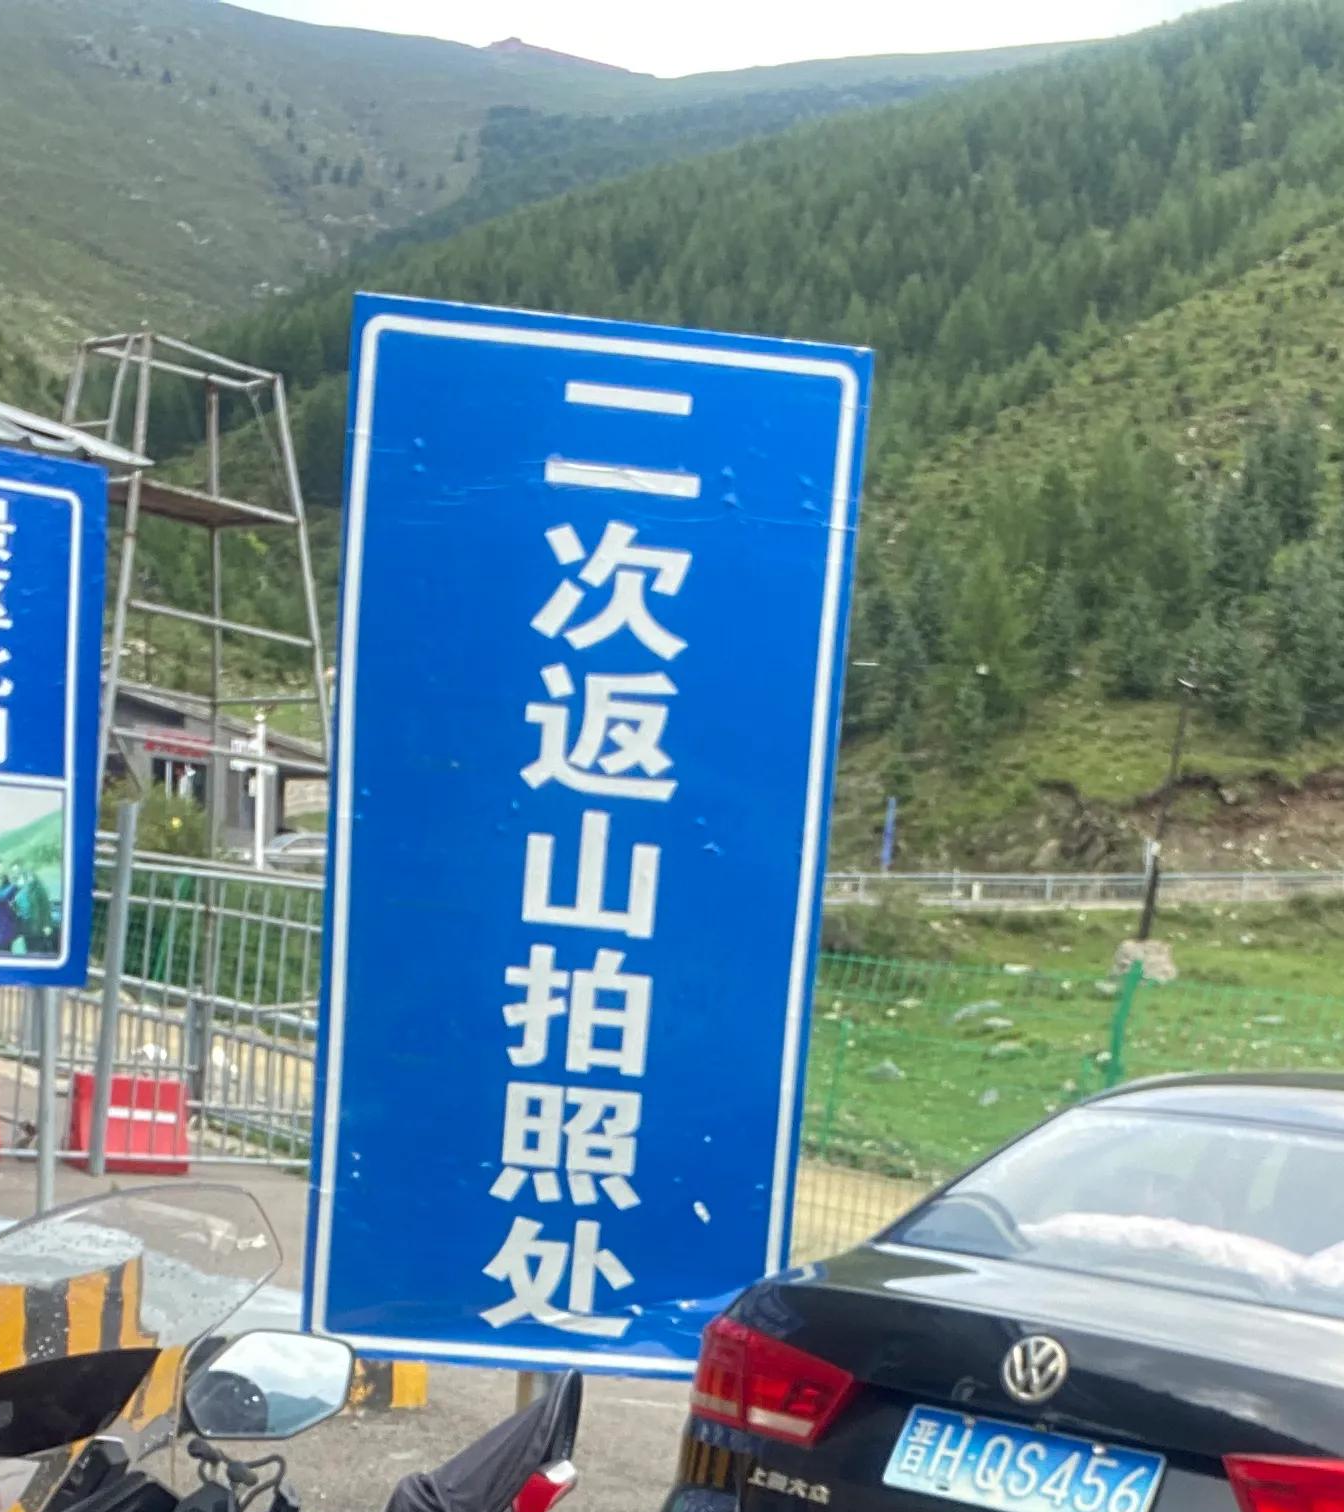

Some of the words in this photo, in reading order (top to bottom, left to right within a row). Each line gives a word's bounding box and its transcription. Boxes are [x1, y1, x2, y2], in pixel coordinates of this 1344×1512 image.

[480, 381, 701, 1338] 二次返山拍照处
